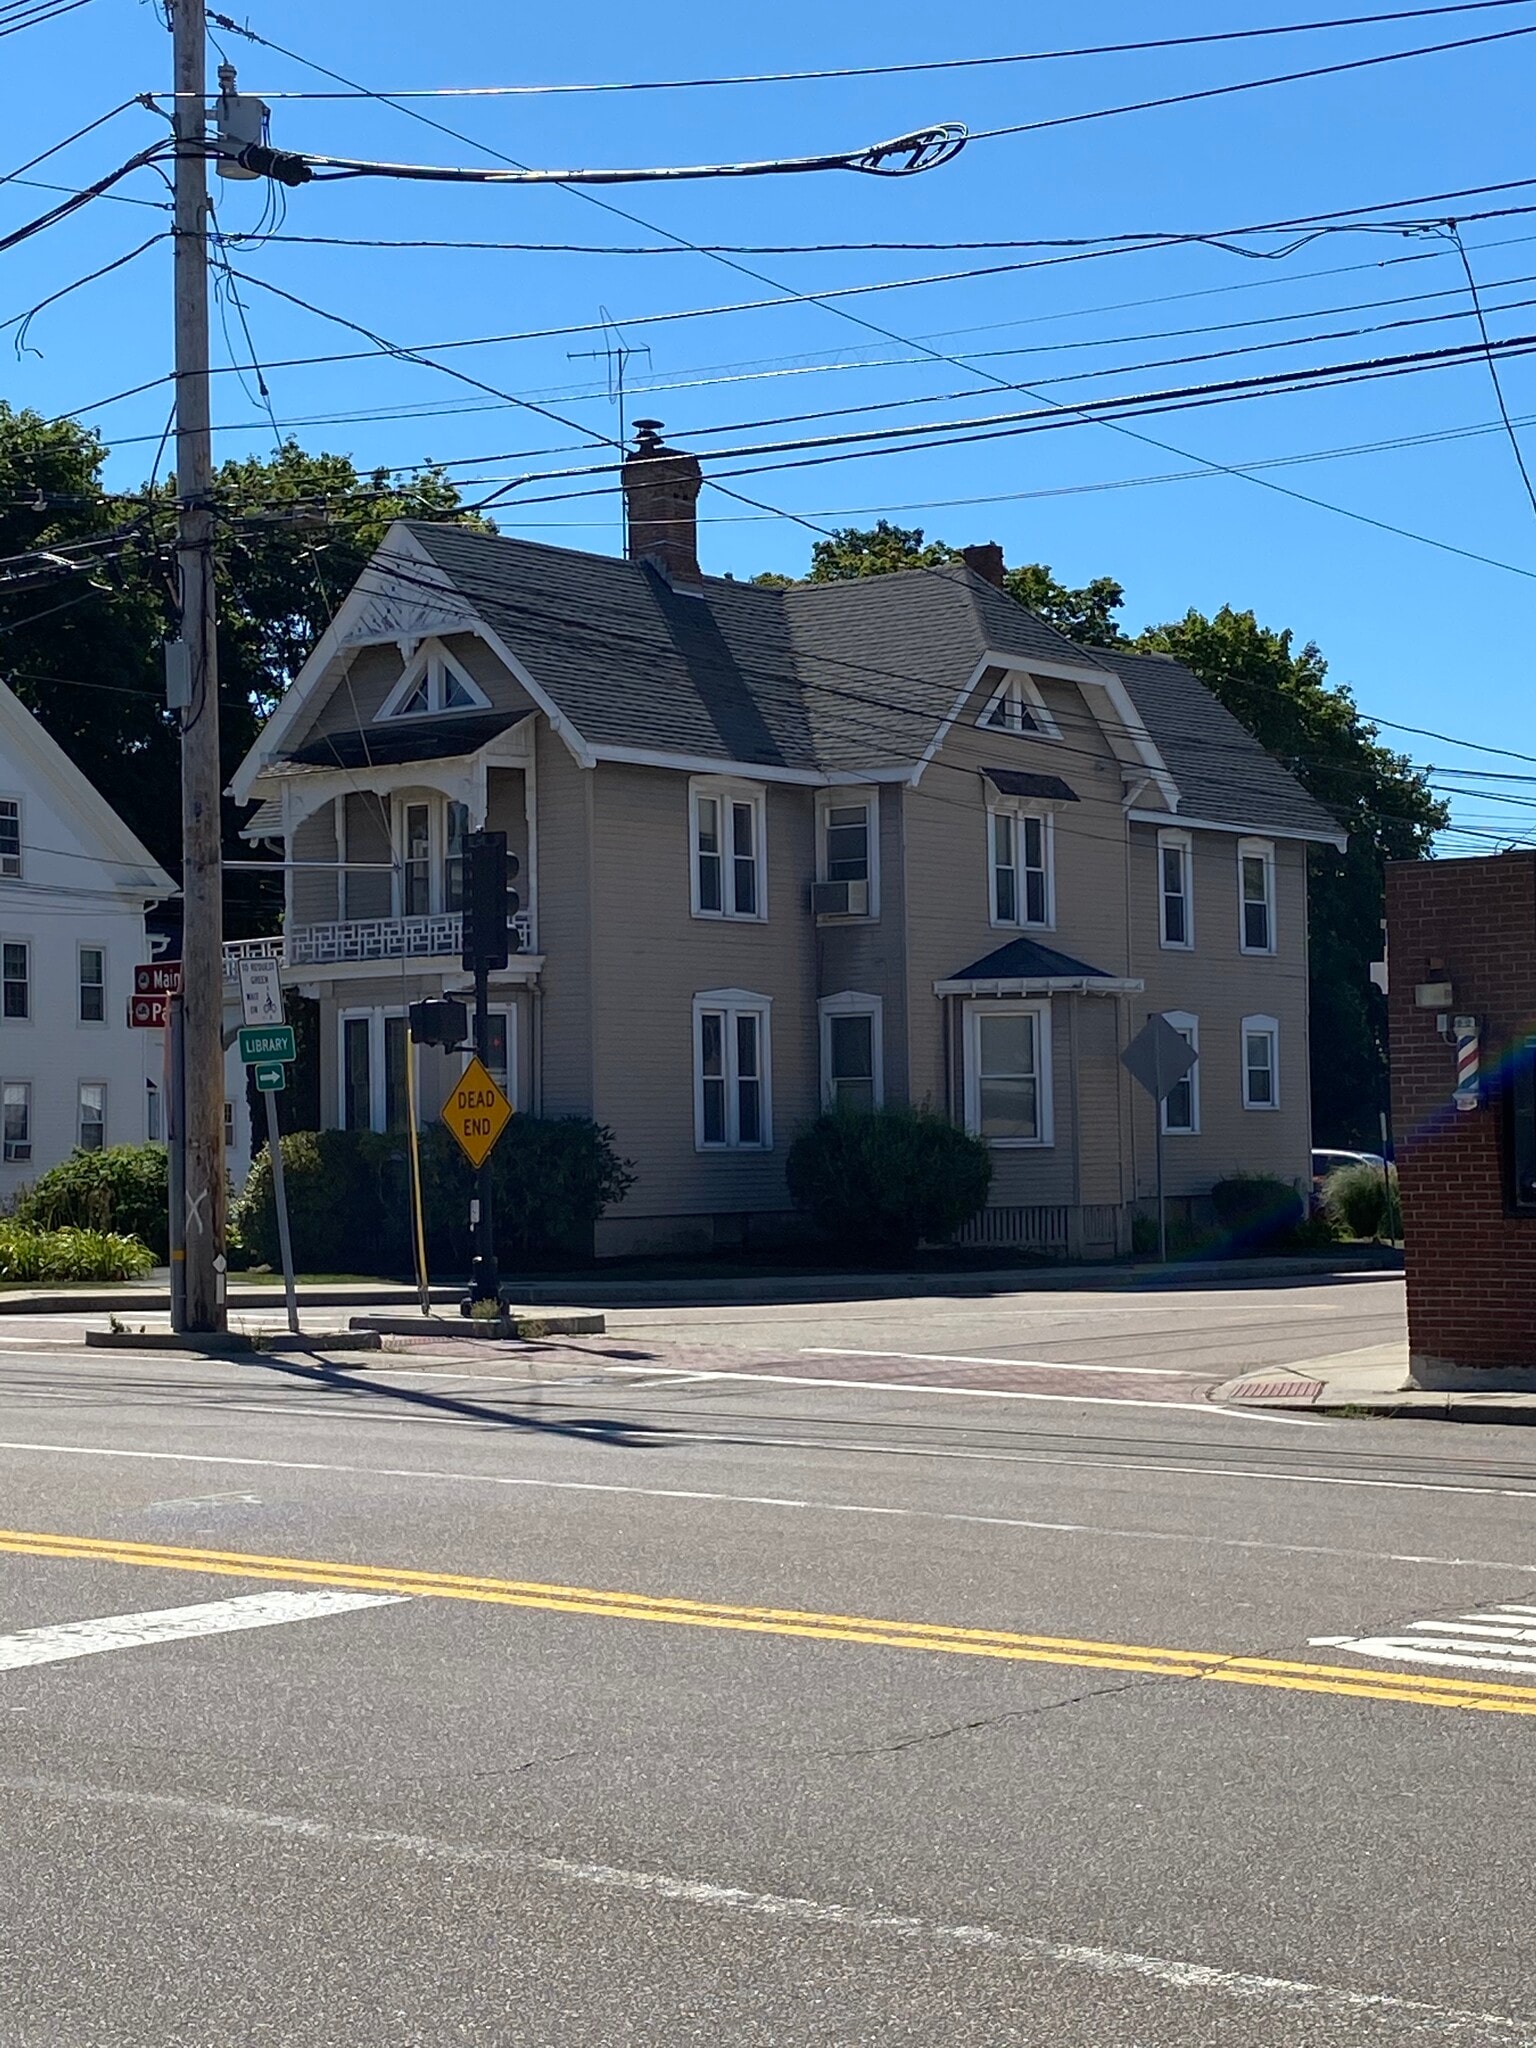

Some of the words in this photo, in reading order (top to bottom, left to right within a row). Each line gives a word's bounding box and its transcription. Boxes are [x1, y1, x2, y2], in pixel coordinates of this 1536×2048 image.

[153, 969, 181, 988] Main
[245, 1036, 288, 1053] LIBRARY
[458, 1089, 495, 1110] DEAD
[464, 1117, 491, 1137] END
